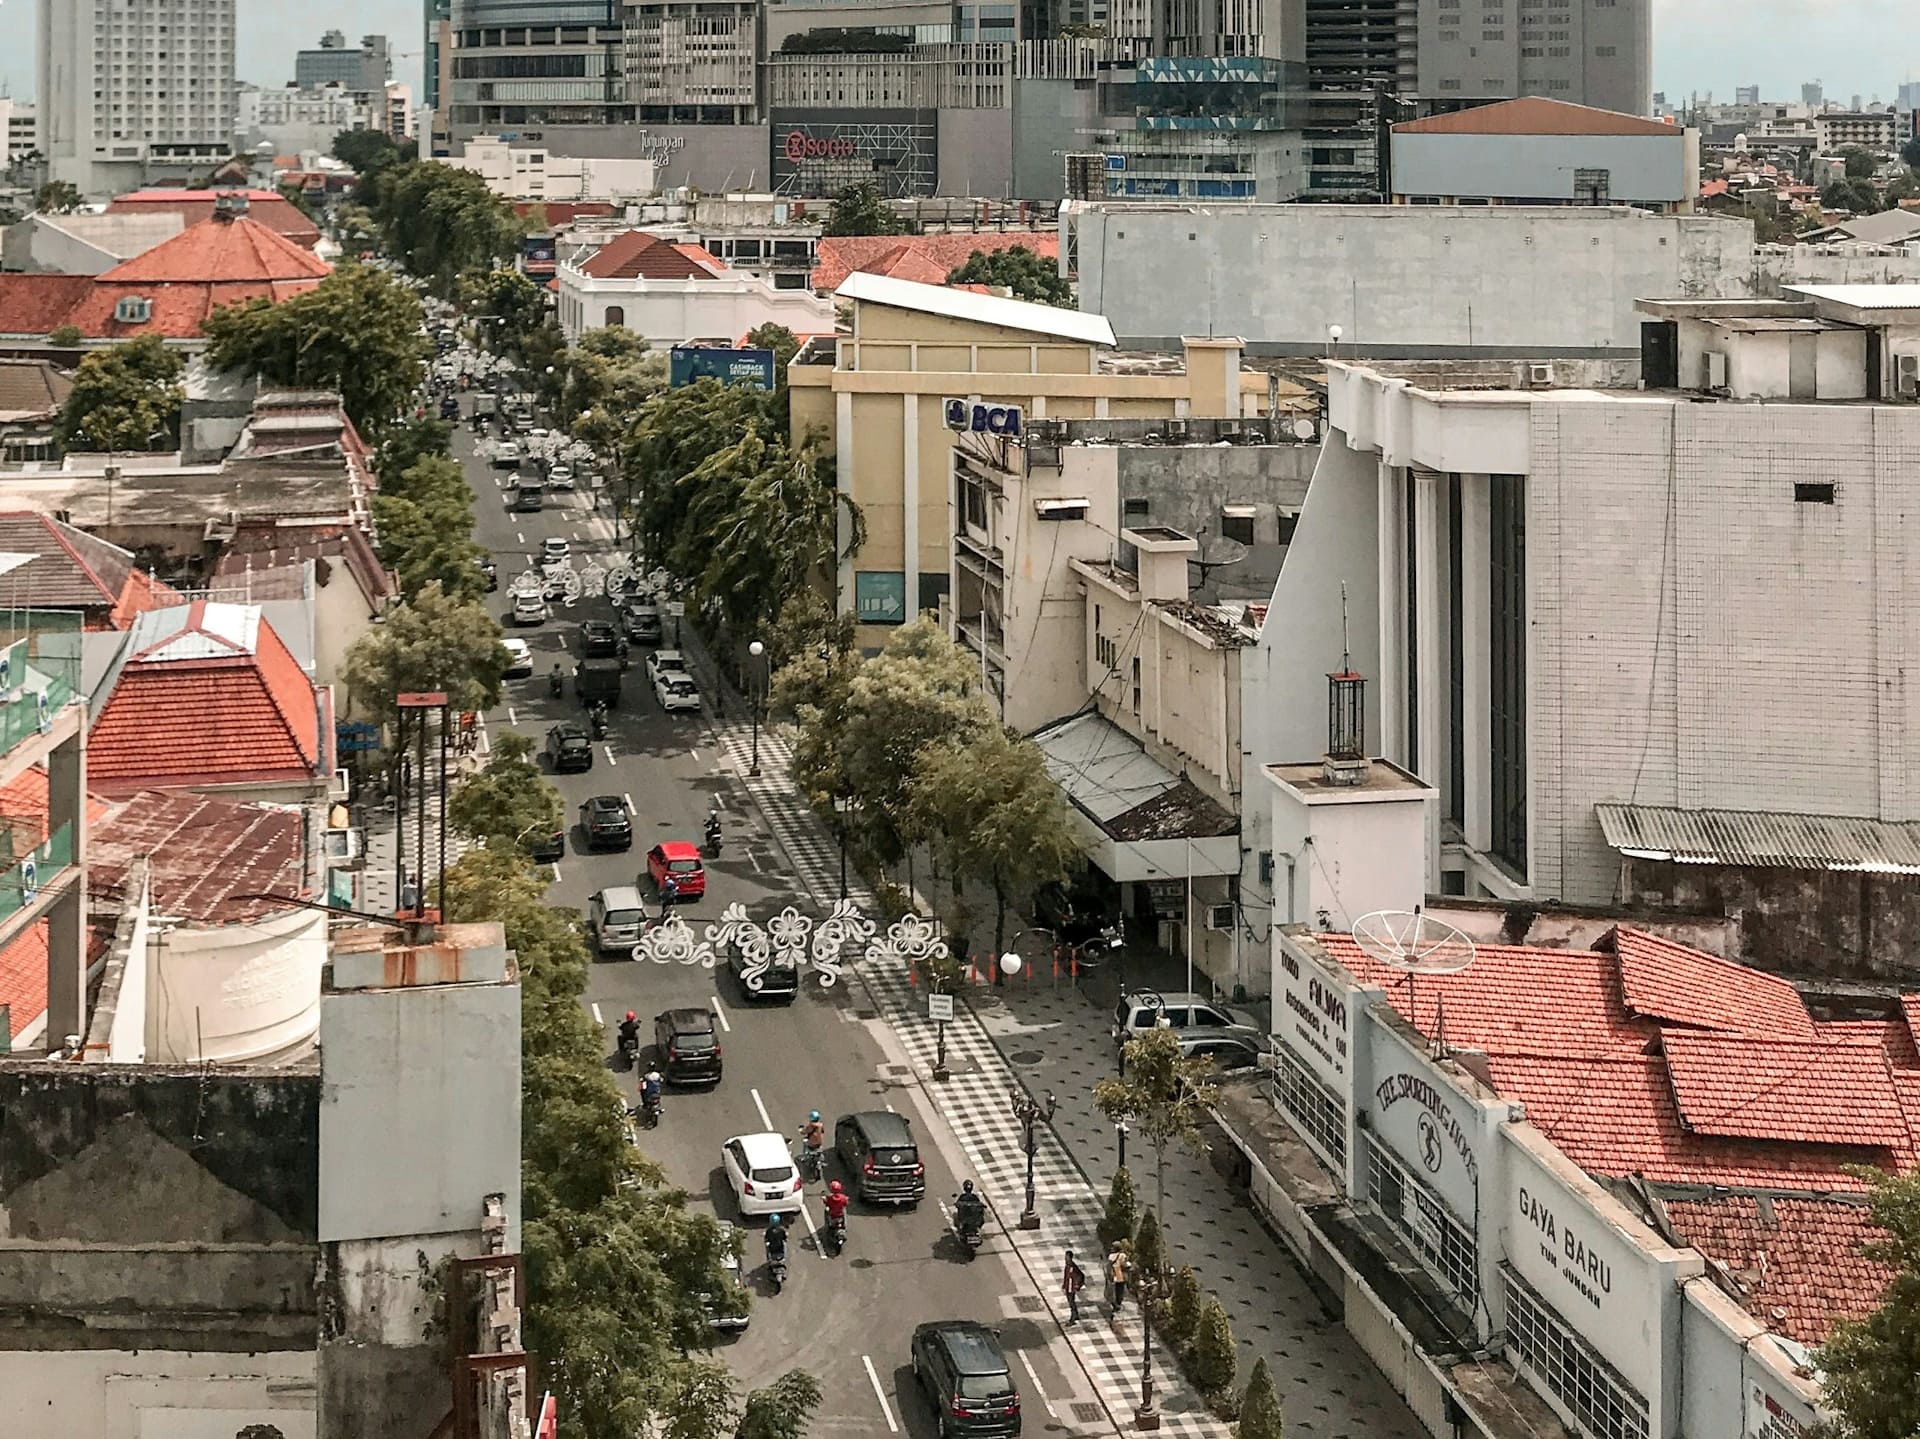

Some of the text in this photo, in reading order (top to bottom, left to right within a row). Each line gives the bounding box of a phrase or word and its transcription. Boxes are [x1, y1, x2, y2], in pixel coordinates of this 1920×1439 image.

[971, 405, 1019, 436] BCA
[1280, 949, 1347, 1033] TOKO ALWA
[1376, 1076, 1398, 1112] THE
[1397, 1073, 1451, 1130] SPORTING
[1519, 1186, 1610, 1293] GAYA BARU
